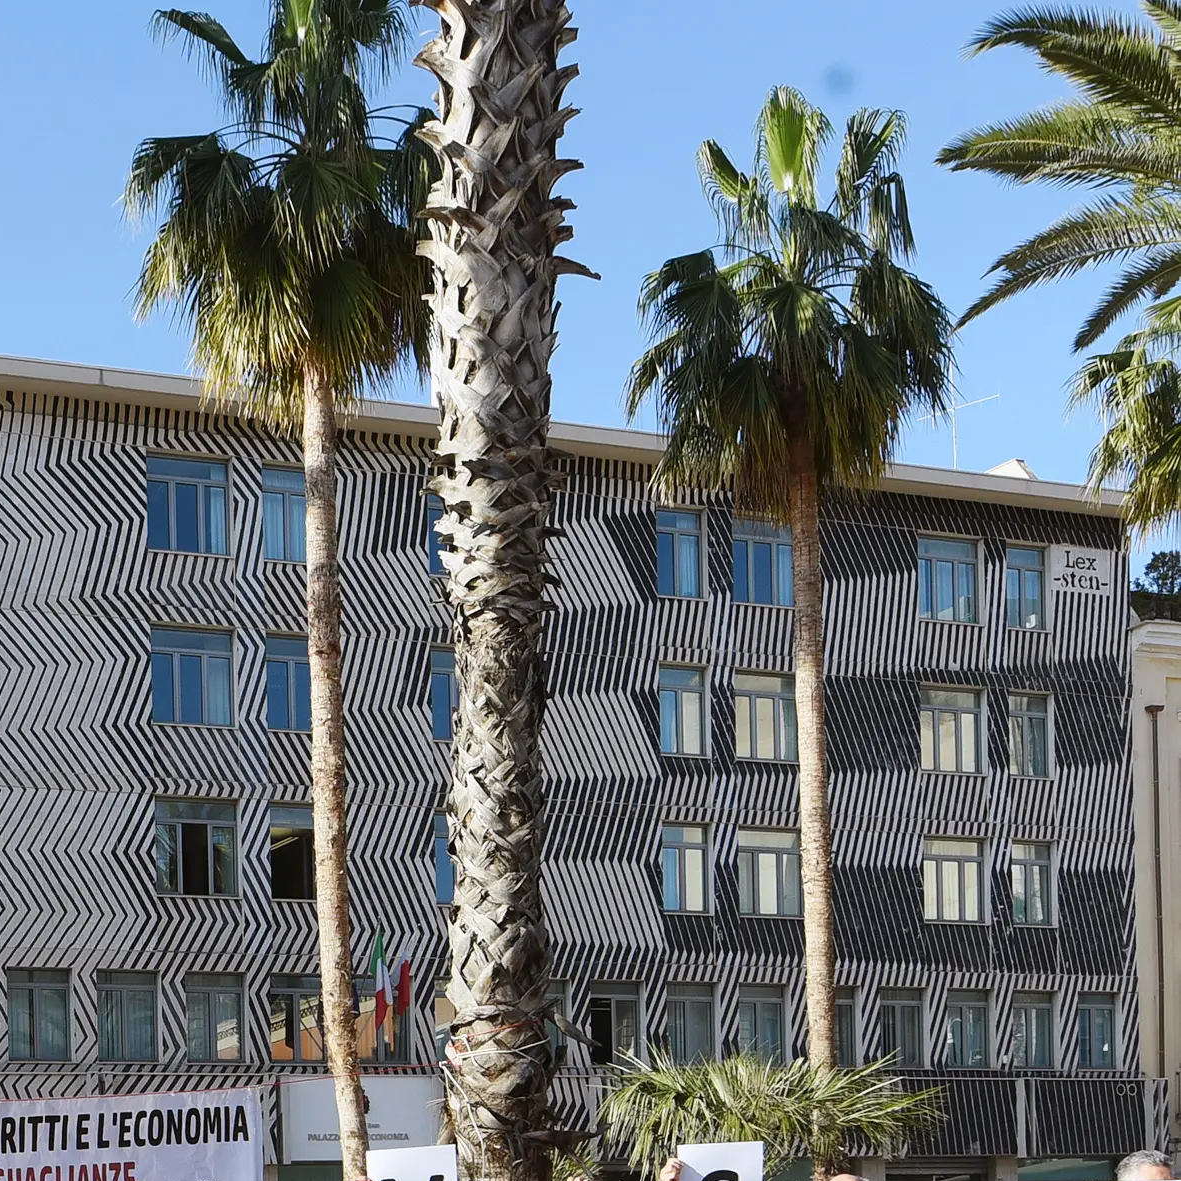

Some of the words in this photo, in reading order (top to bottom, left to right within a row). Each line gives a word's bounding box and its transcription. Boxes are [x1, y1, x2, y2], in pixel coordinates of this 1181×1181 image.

[1064, 550, 1097, 571] Lex
[76, 1113, 91, 1151] E
[97, 1104, 249, 1149] L'ECONOMIA
[307, 1133, 340, 1142] PALAZZ
